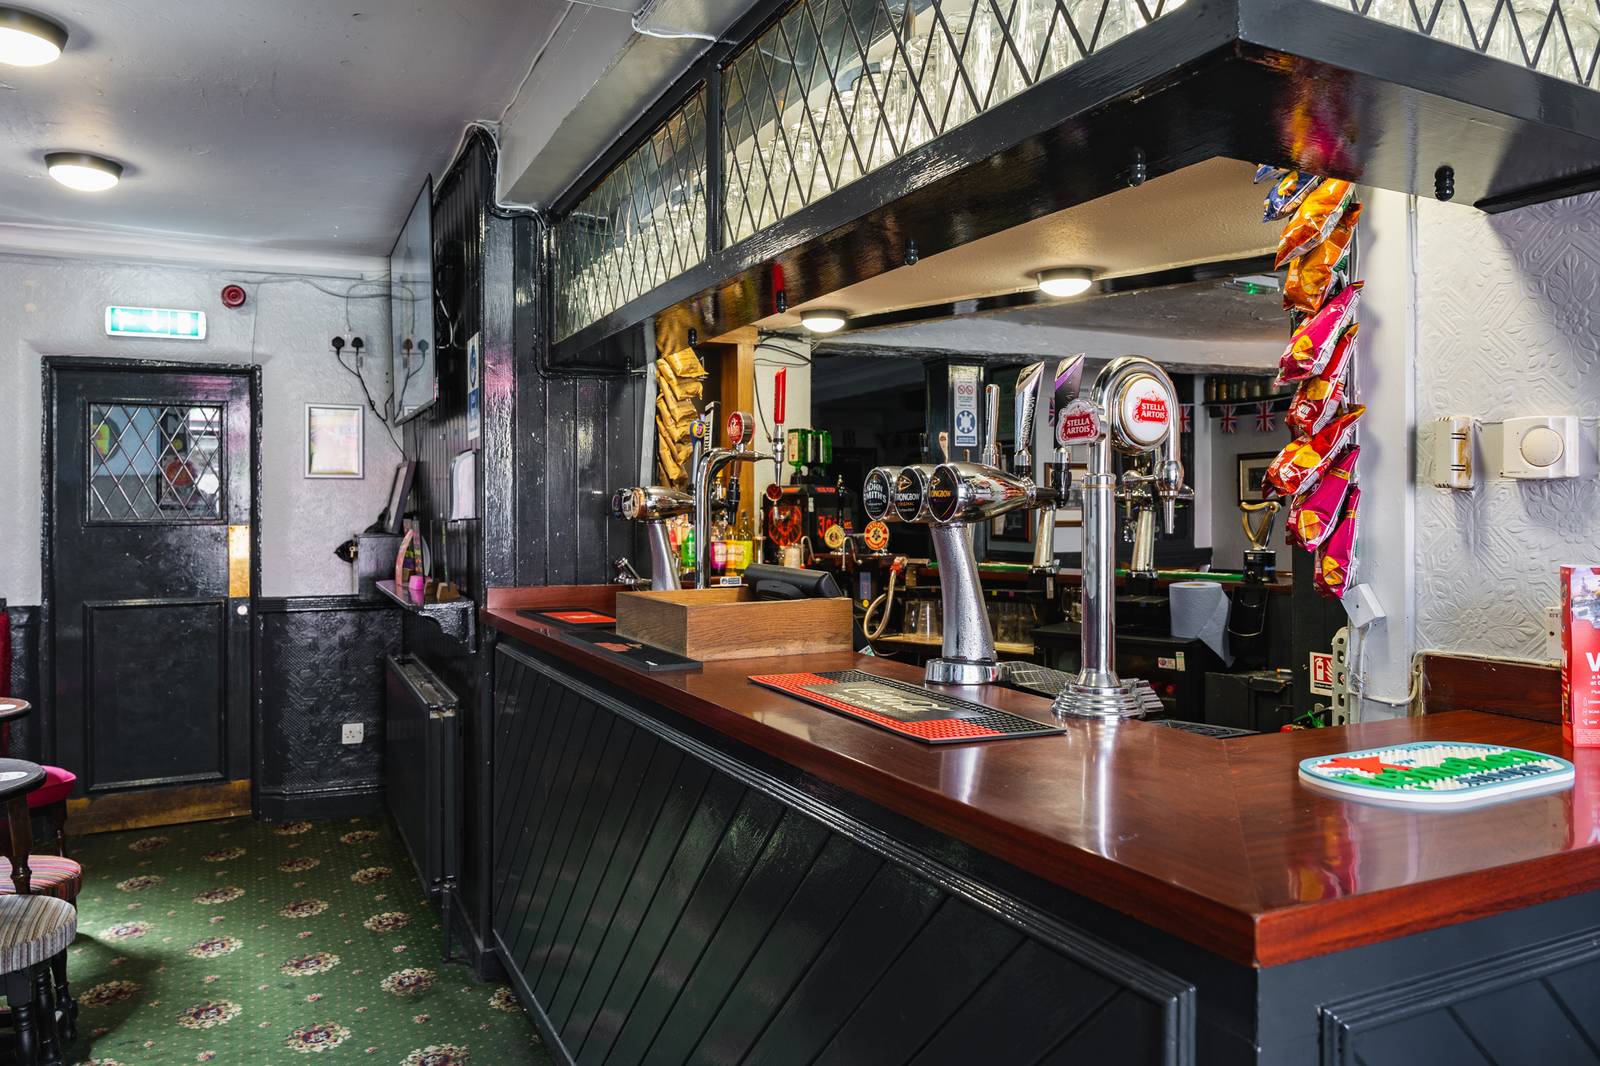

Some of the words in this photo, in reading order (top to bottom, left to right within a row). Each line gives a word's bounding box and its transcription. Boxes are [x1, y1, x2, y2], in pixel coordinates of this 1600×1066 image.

[1140, 402, 1166, 412] STELLA
[1140, 410, 1166, 419] ARTOIS
[1066, 417, 1090, 427] STELLA
[1066, 425, 1091, 435] ARTOIS
[894, 492, 920, 501] TRONGBOW
[929, 489, 952, 497] ONGBOW
